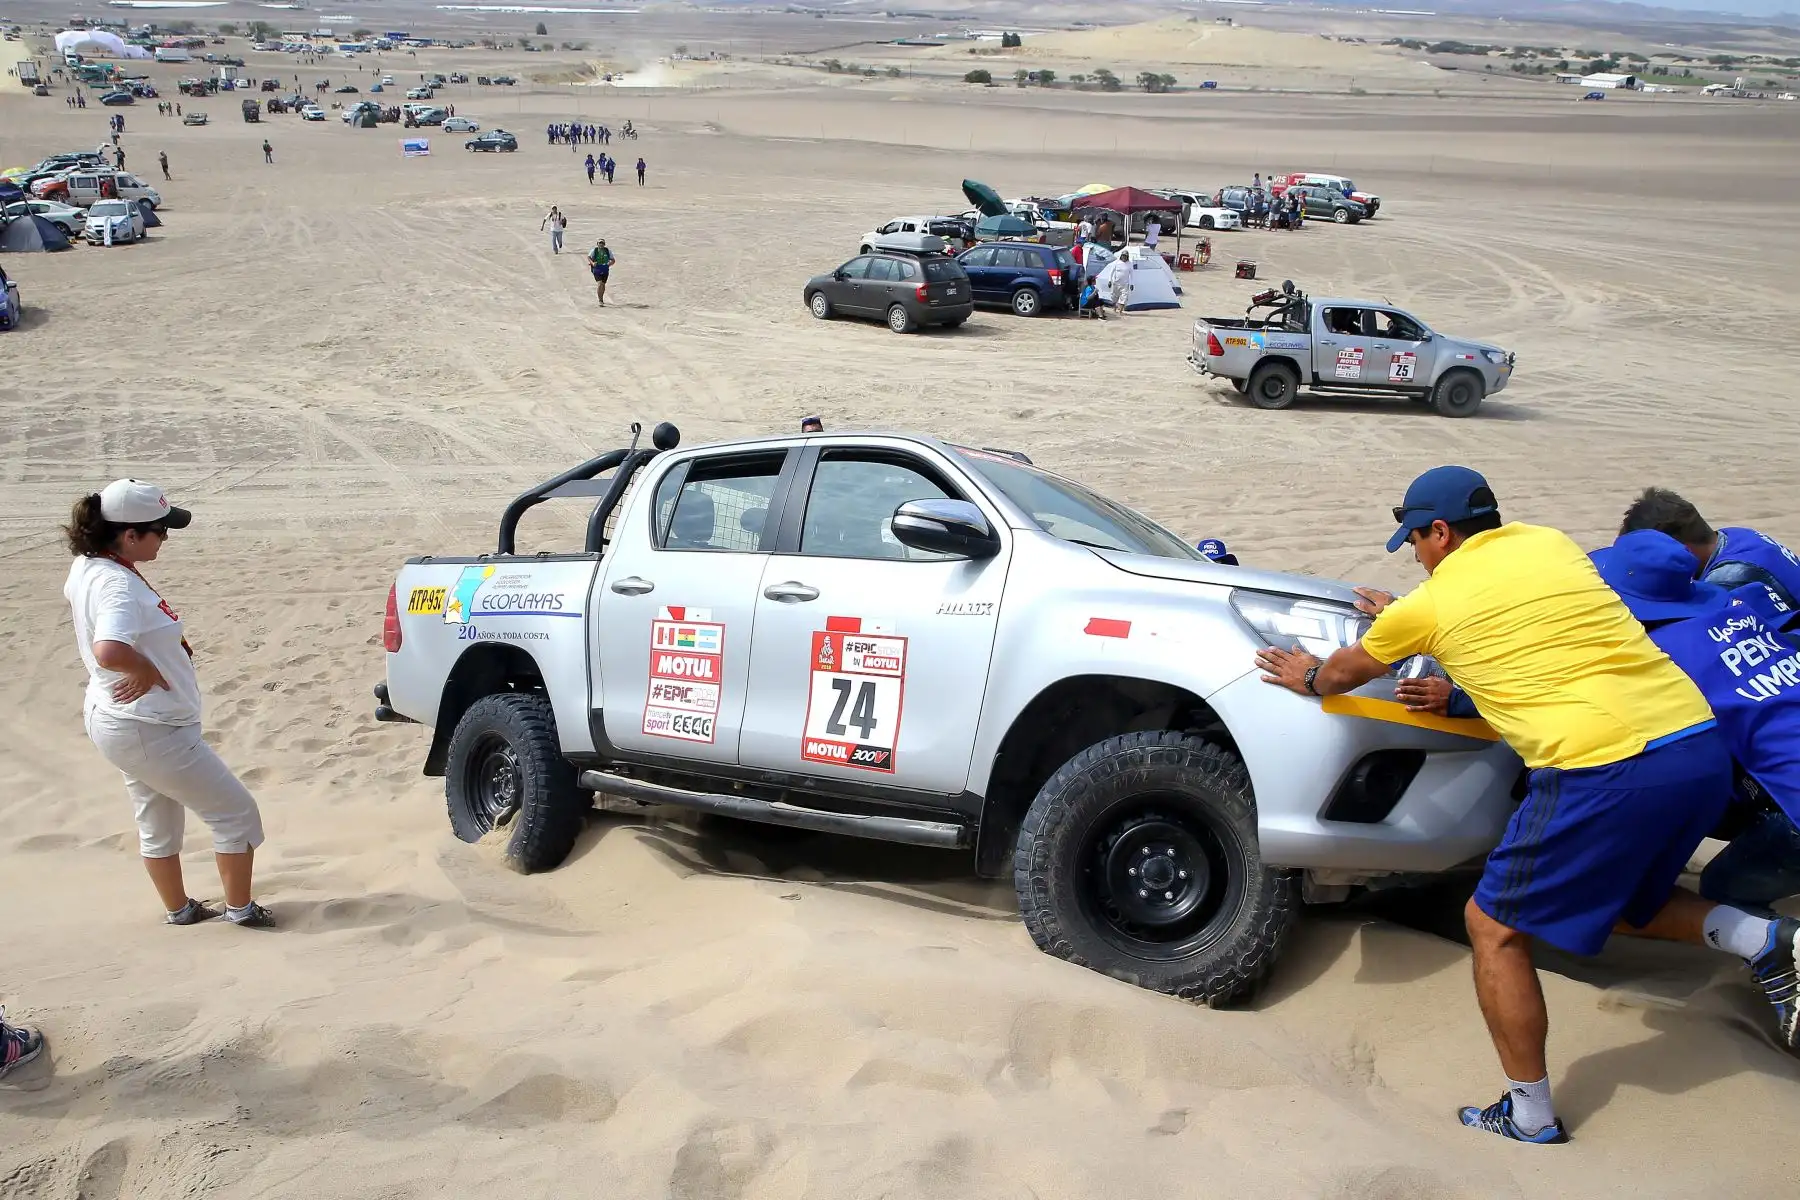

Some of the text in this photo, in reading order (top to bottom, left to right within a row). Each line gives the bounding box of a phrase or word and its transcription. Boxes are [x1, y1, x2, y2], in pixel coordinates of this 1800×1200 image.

[482, 593, 565, 610] ECOPLAYAS
[458, 625, 477, 640] 20
[477, 630, 496, 640] AÑOS
[502, 632, 521, 640] TODA
[523, 632, 550, 640] COSTA
[657, 655, 714, 678] MOTUL
[864, 655, 899, 669] MOTUL
[646, 719, 670, 731] sport
[807, 742, 889, 764] MOTUL 300V
